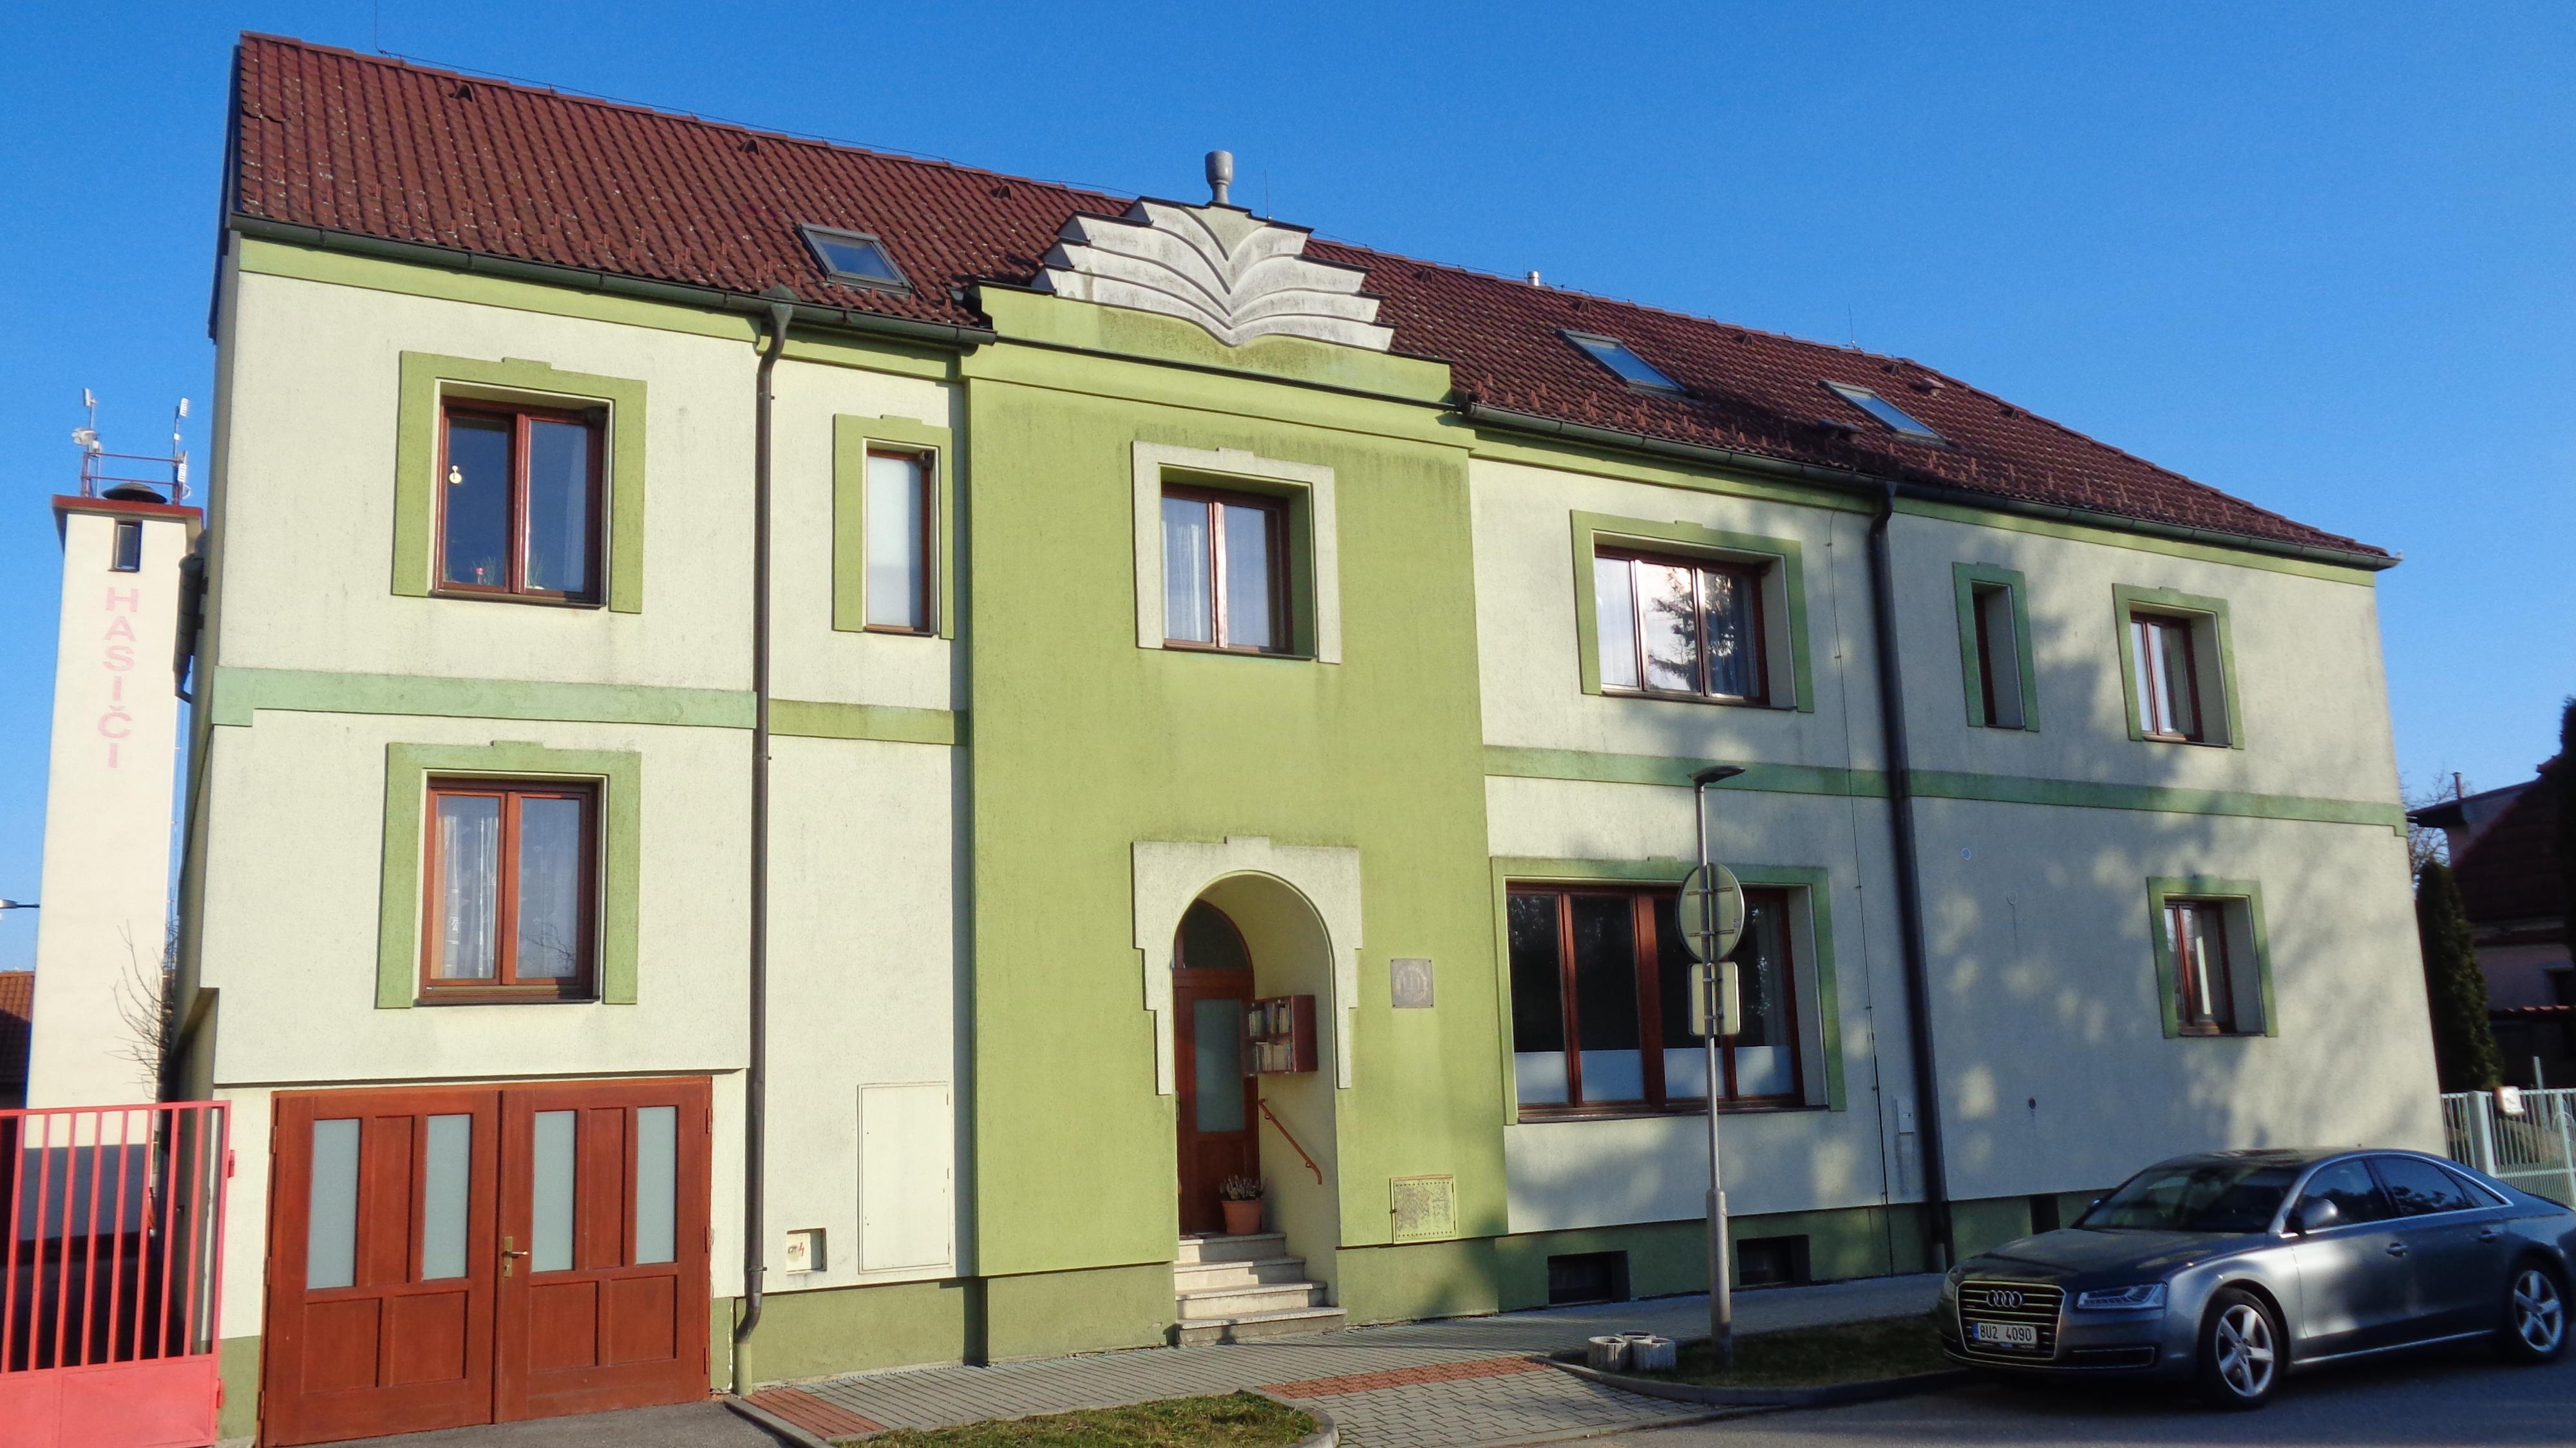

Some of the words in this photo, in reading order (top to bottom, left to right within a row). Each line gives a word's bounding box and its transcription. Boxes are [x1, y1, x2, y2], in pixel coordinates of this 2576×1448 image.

[97, 587, 138, 768] HASIČI
[1980, 1325, 1998, 1339] 8U2
[2006, 1327, 2032, 1341] 4090
